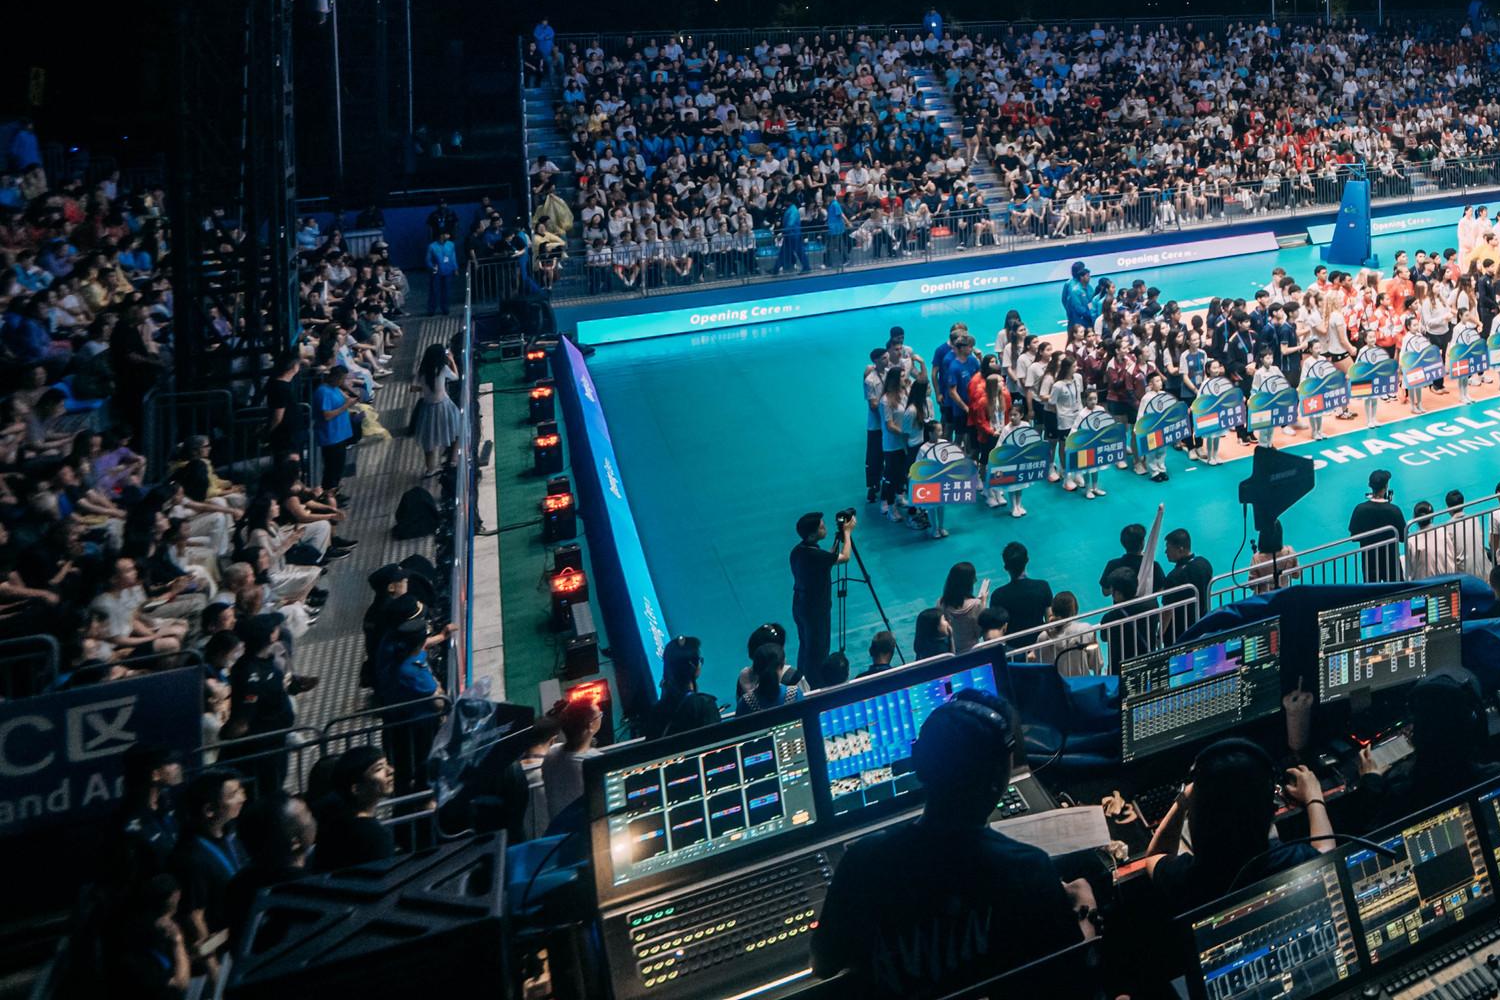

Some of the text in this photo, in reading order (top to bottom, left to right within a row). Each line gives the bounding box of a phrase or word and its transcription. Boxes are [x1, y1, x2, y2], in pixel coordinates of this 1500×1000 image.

[1116, 252, 1160, 267] Opening
[920, 278, 970, 294] Opening
[690, 308, 749, 325] Opening
[1373, 383, 1395, 394] GER
[1325, 395, 1347, 408] HKG
[1220, 414, 1243, 428] LUX
[1164, 426, 1190, 444] MDA
[1097, 451, 1124, 465] ROU
[1017, 470, 1044, 482] SVK
[943, 492, 972, 502] TUR
